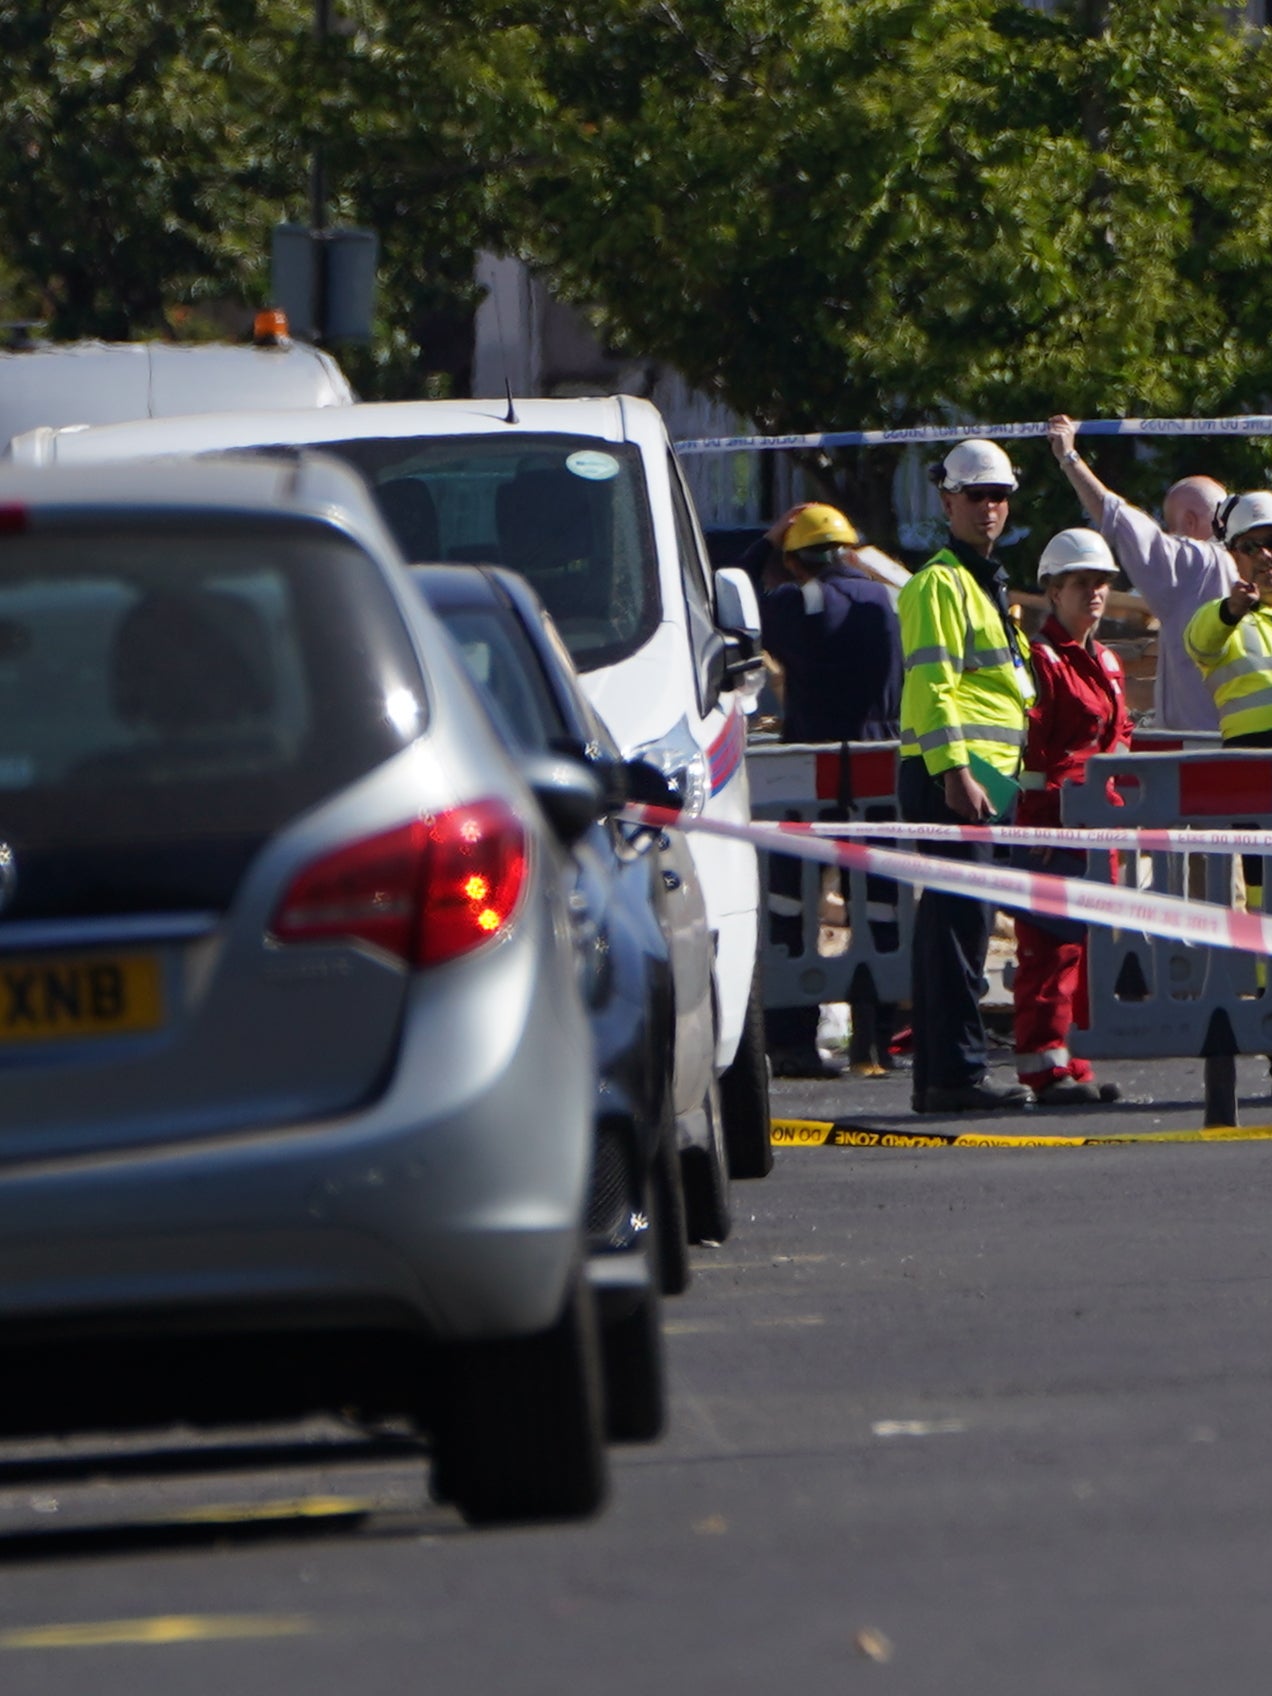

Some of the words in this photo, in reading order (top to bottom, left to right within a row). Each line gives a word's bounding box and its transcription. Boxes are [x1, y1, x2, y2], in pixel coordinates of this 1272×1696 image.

[771, 1127, 794, 1142] NO
[799, 1128, 821, 1142] DO
[835, 1130, 880, 1146] ZONE
[881, 1133, 948, 1147] HAZARD
